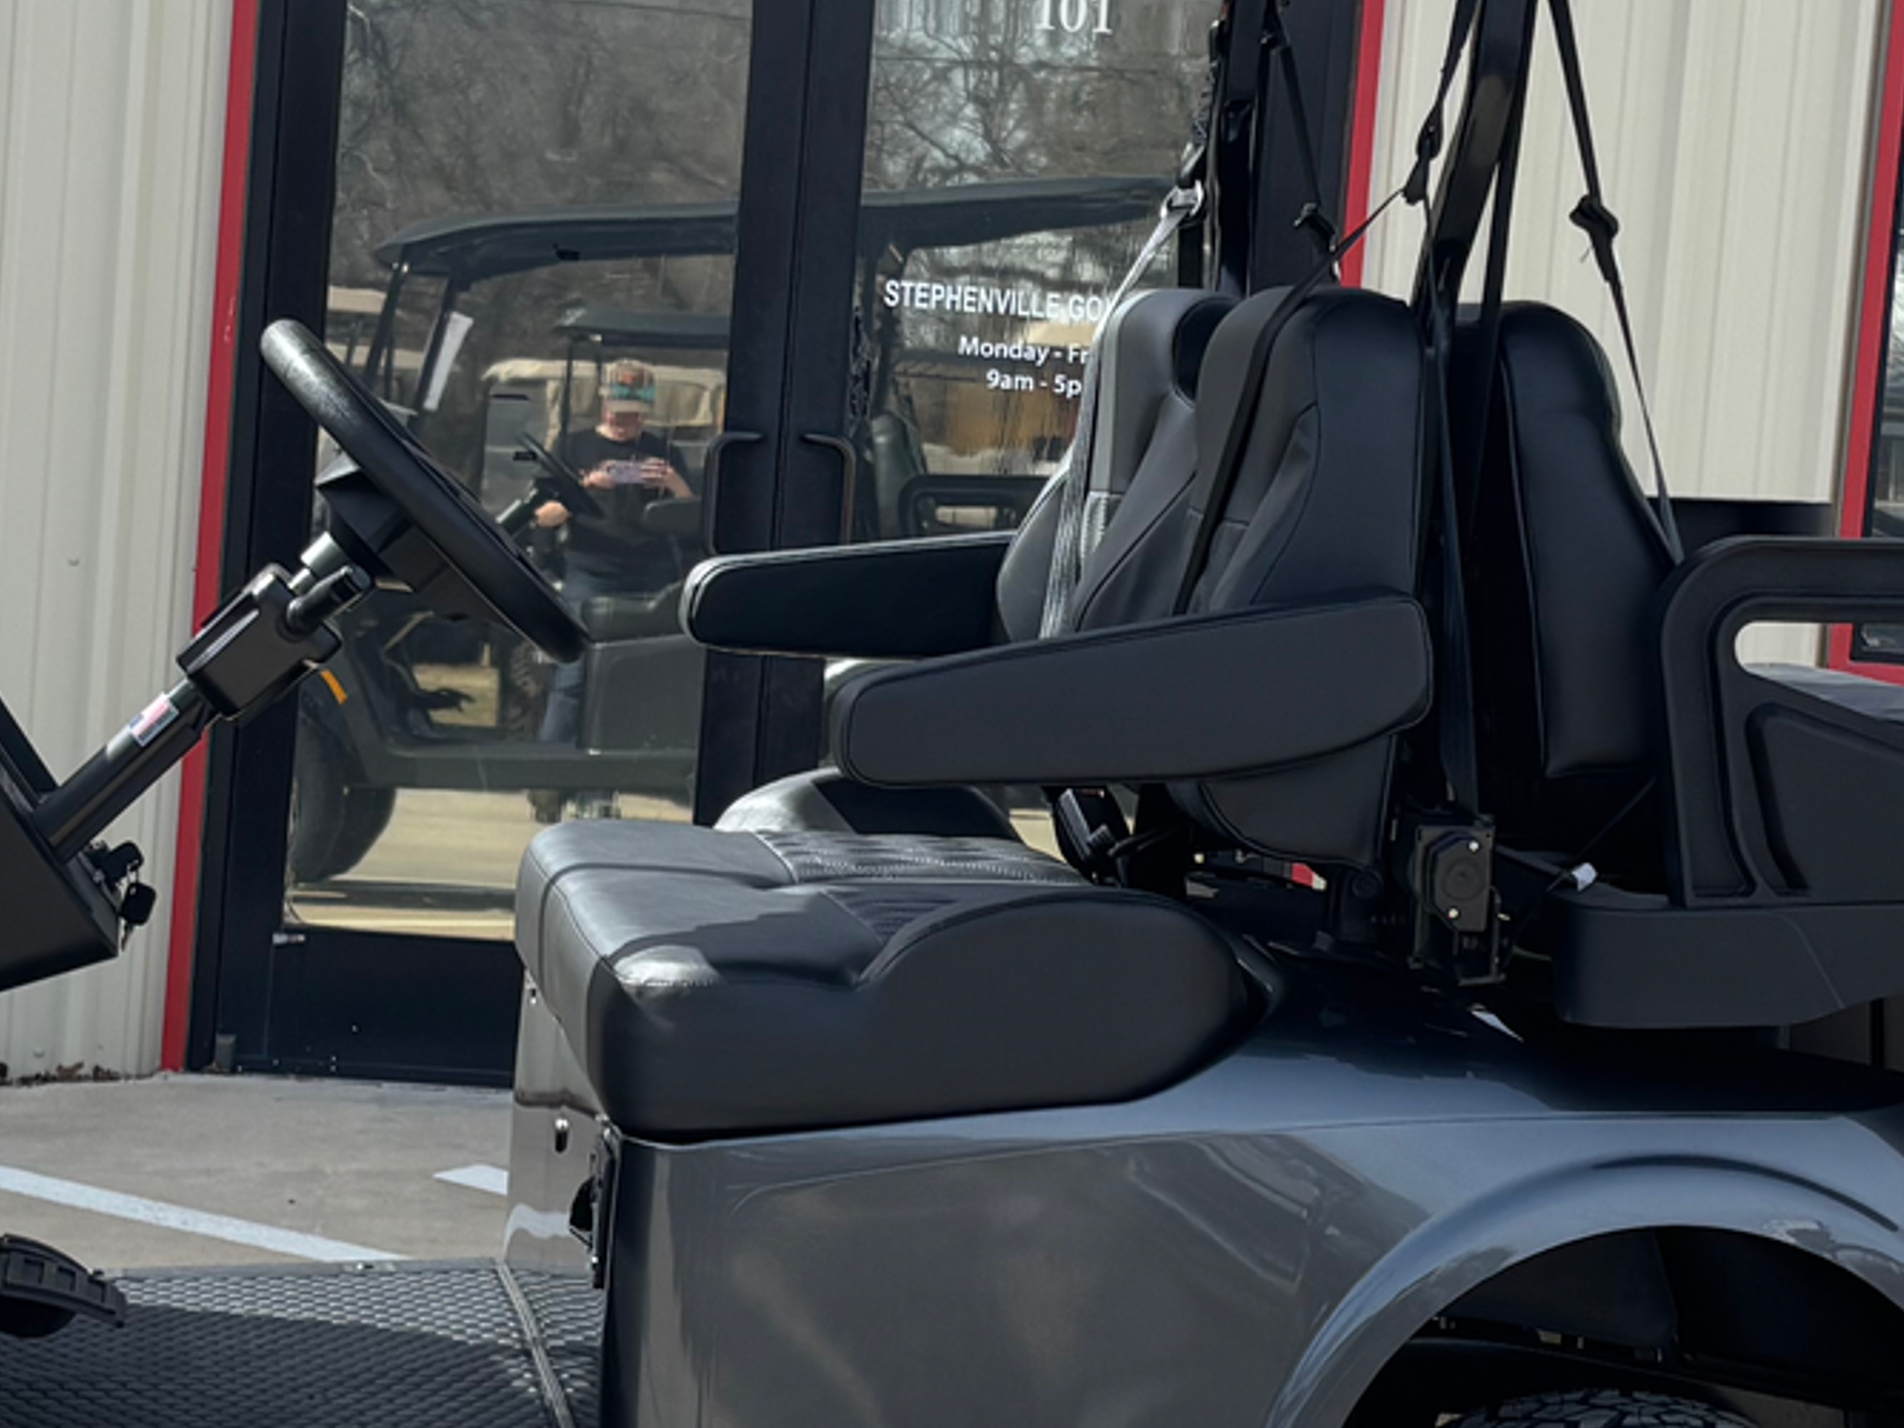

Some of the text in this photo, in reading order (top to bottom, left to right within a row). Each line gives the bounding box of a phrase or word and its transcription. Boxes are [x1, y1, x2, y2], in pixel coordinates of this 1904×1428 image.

[883, 279, 1060, 320] STEPHENVILLE
[957, 335, 1050, 366] Monday
[1068, 343, 1088, 364] Fr
[985, 368, 1034, 392] 9am
[1052, 373, 1083, 399] 5p
